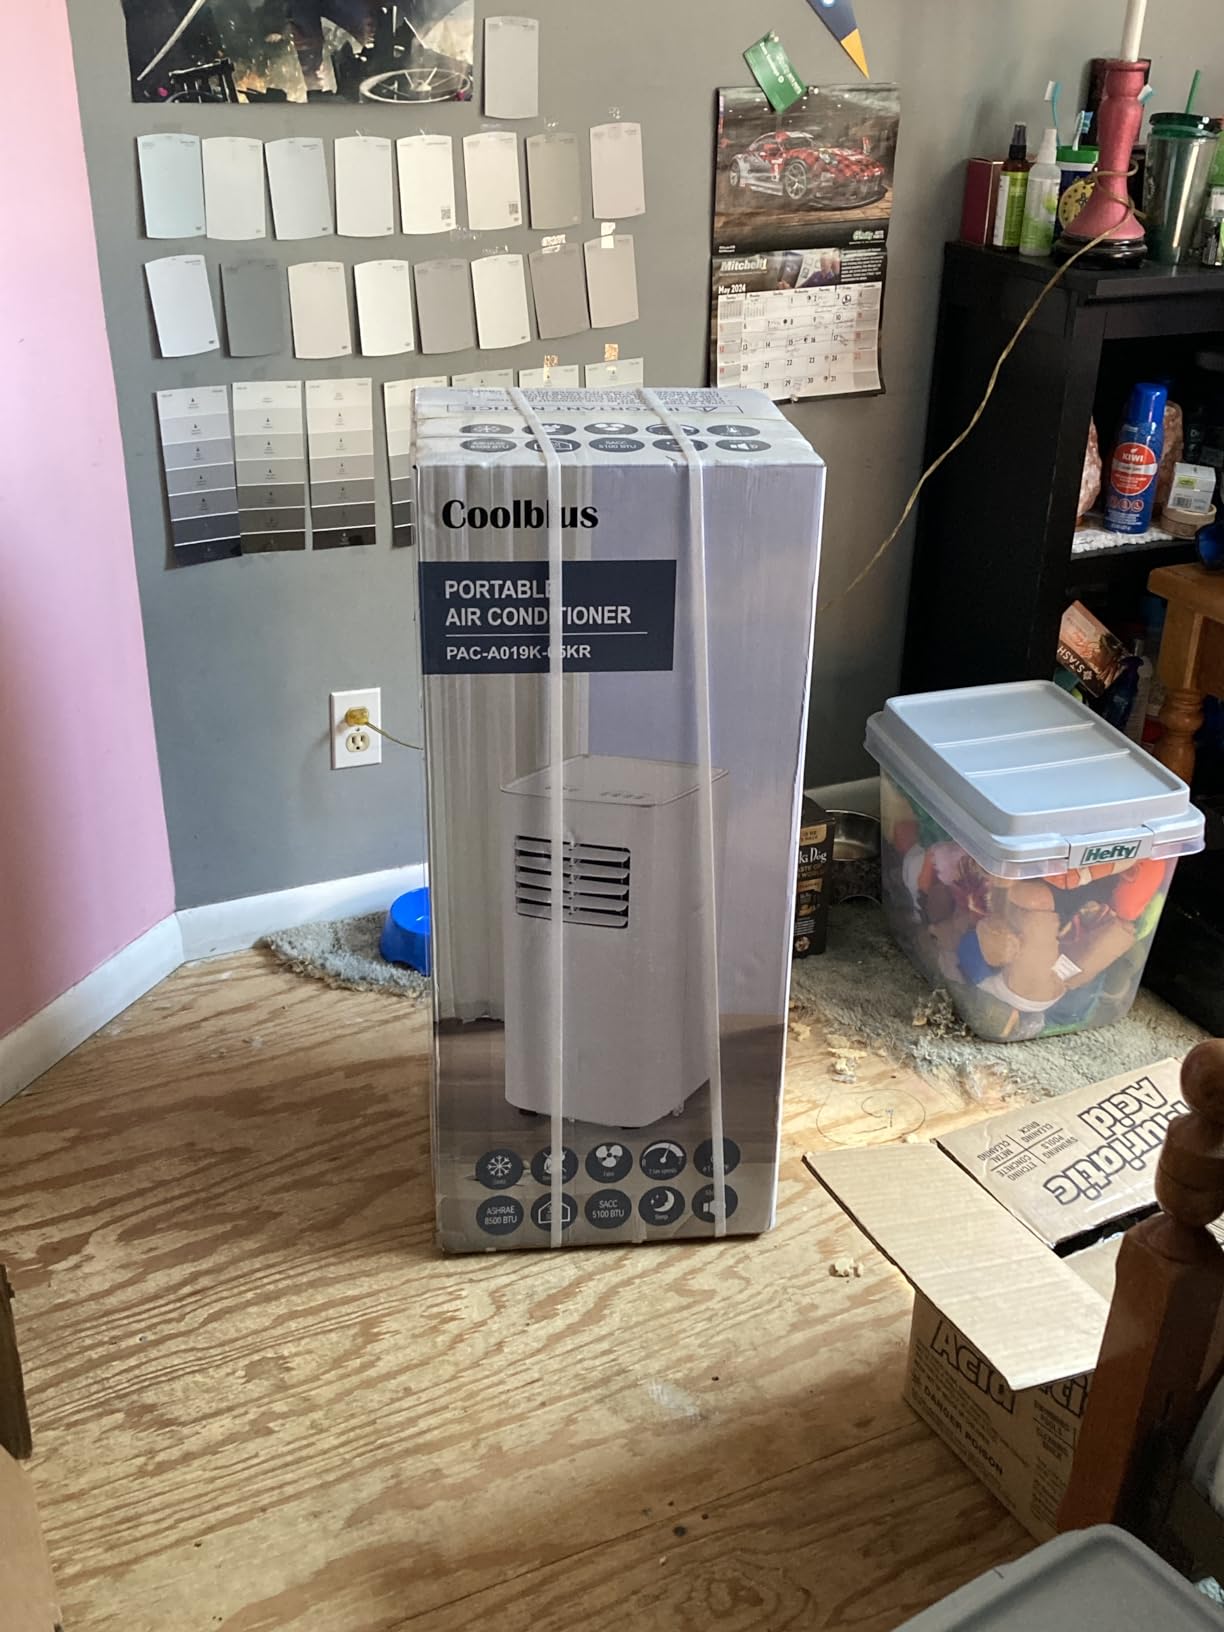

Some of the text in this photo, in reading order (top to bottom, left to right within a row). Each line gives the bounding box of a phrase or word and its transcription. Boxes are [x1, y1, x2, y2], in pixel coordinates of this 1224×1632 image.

[718, 283, 746, 296] May 2024
[1122, 451, 1144, 462] KIWI
[442, 499, 599, 529] Coolbus
[445, 605, 631, 626] AIR CONDIONER
[1057, 645, 1085, 673] STASH
[810, 847, 827, 863] Dog
[1084, 845, 1136, 861] Hefty
[1077, 1076, 1168, 1140] Acid
[1017, 1120, 1040, 1135] BRICK
[1020, 1123, 1054, 1143] CLEANING
[977, 1140, 1011, 1161] CLEANING
[1040, 1134, 1064, 1149] POOLS
[1042, 1136, 1079, 1159] SWIMMING
[989, 1148, 1014, 1163] METAL
[1043, 1100, 1192, 1205] uriatic
[996, 1154, 1032, 1177] CONCRETE
[1007, 1161, 1038, 1181] ETCHING
[486, 1205, 515, 1215] ASHRAE
[599, 1200, 618, 1208] SACC
[484, 1215, 518, 1225] 8500 BTU
[592, 1209, 625, 1219] 5100 BTU
[964, 1431, 1003, 1475] POISON
